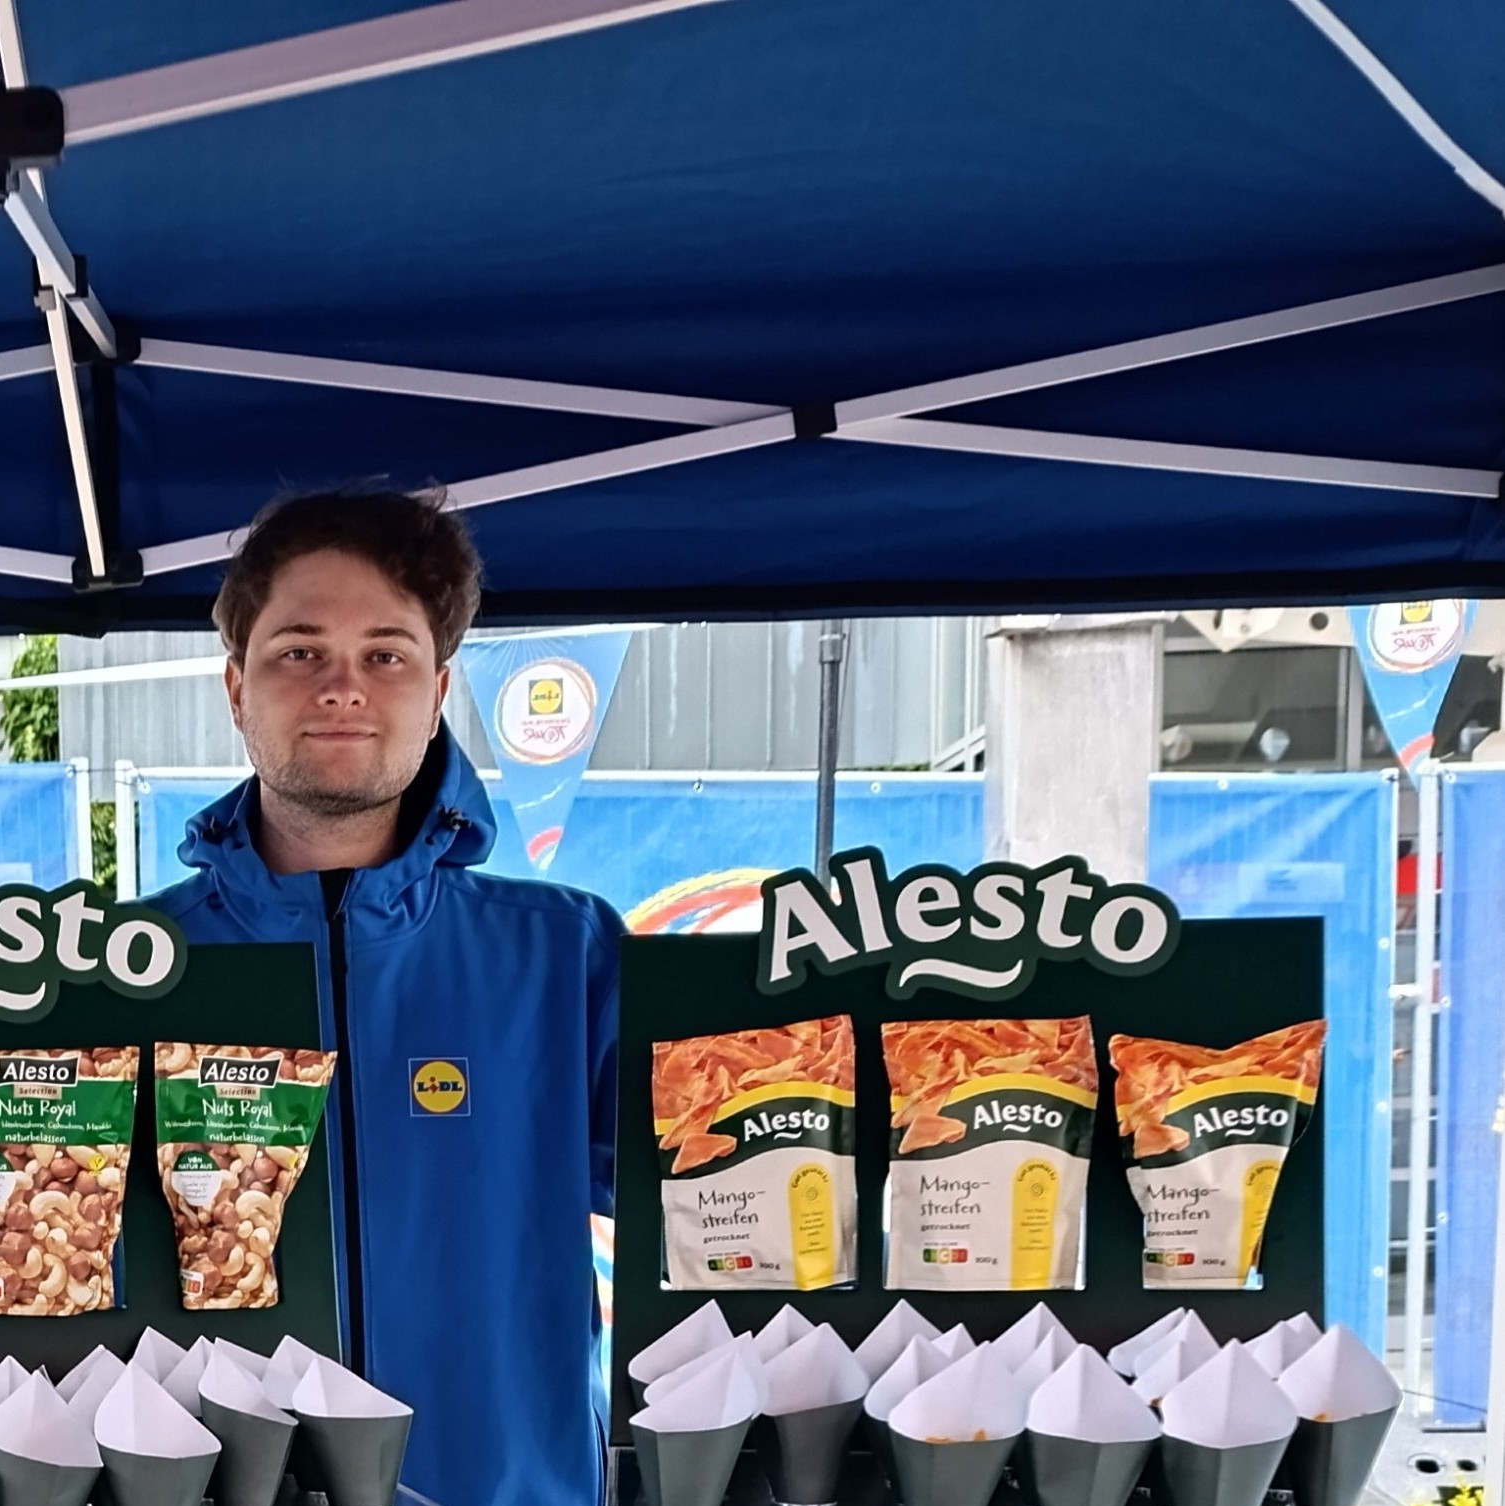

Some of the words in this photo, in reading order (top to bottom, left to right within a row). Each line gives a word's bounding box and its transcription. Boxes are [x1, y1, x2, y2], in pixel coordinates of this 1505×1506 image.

[770, 857, 1169, 983] Alesto
[2, 1061, 70, 1081] Alesto
[204, 1061, 270, 1082] Alesto
[19, 1086, 58, 1096] Selection
[219, 1087, 257, 1097] Selection
[40, 1100, 76, 1122] Royal
[202, 1098, 234, 1117] Nuts
[240, 1099, 273, 1122] Royal
[973, 1100, 1063, 1130] Alesto
[744, 1108, 830, 1142] Alesto
[1194, 1104, 1290, 1138] Alesto
[5, 1131, 66, 1144] naturbelassen
[209, 1131, 265, 1143] naturbelassen
[920, 1174, 990, 1198] Mango-
[1146, 1183, 1221, 1203] Mango-
[698, 1190, 766, 1210] Mango-
[920, 1199, 981, 1216] streifen
[702, 1211, 759, 1229] streifen
[920, 1223, 971, 1232] getrocknet
[703, 1233, 750, 1244] getrocknet
